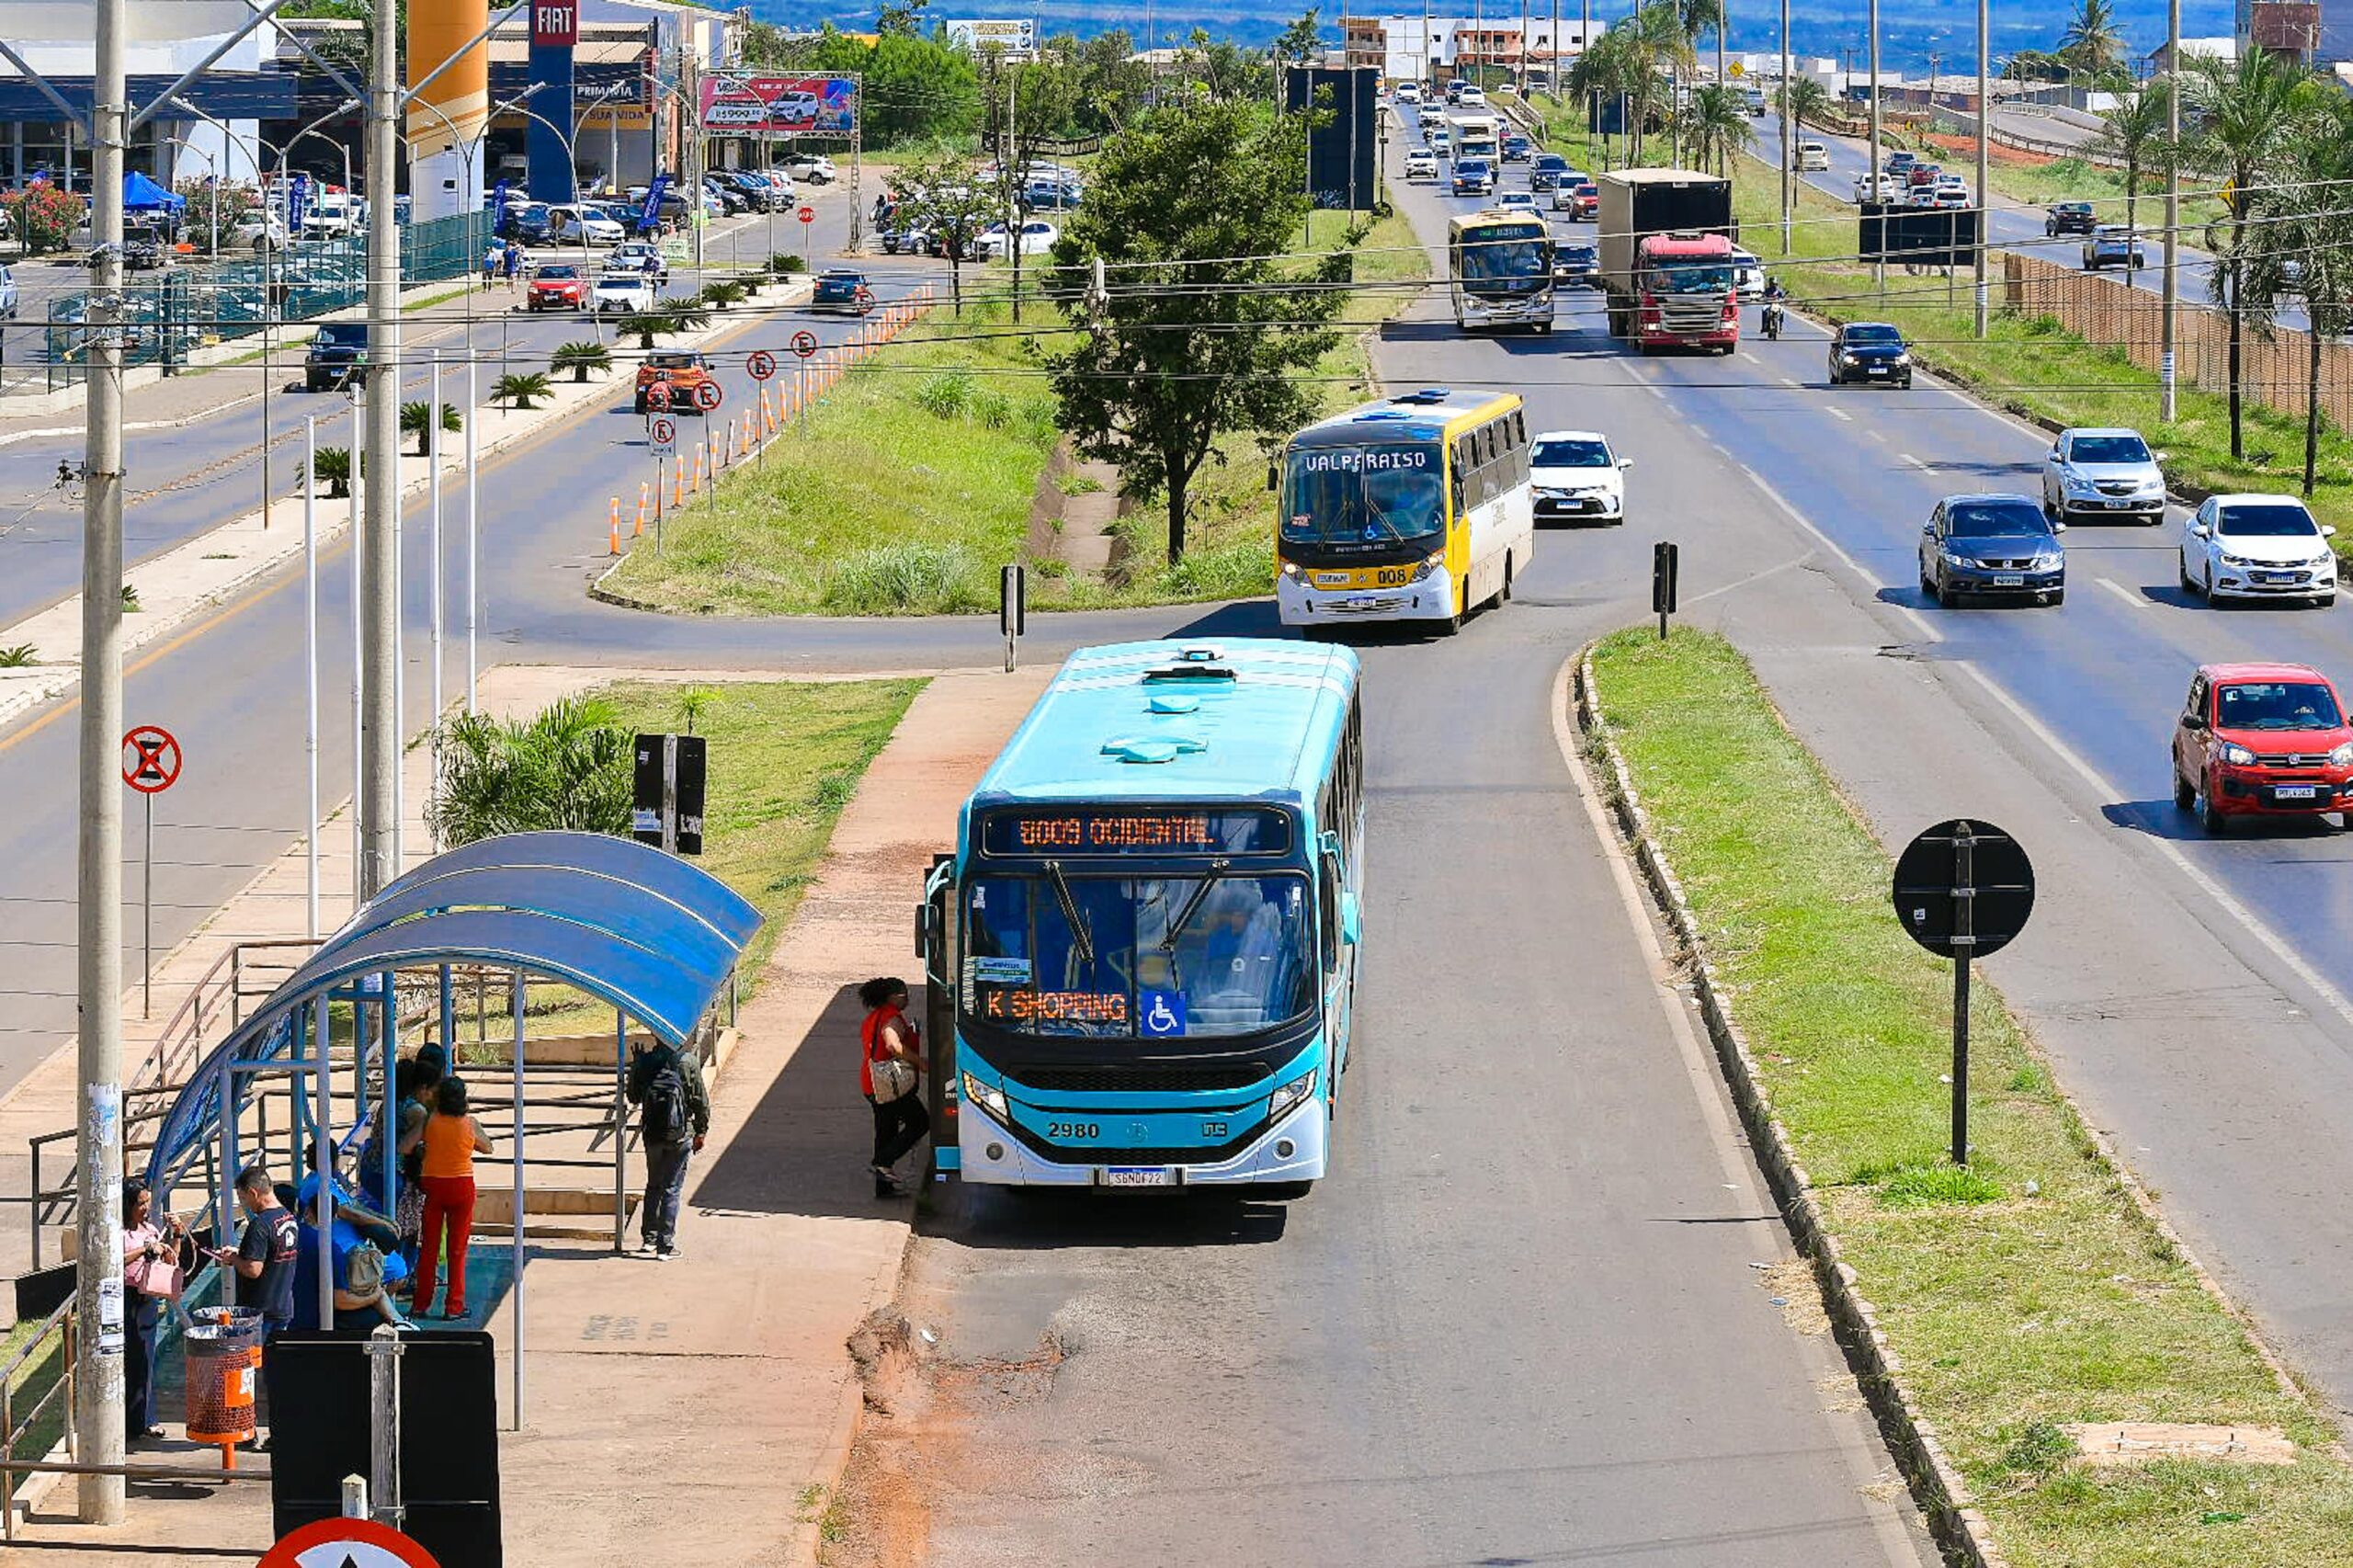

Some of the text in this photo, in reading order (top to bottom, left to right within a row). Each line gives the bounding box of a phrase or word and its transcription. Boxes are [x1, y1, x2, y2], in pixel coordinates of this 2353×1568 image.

[538, 6, 574, 34] FIAT
[1378, 570, 1406, 584] 008
[988, 990, 1126, 1021] K SHOPPING
[1048, 1122, 1100, 1139] 2980
